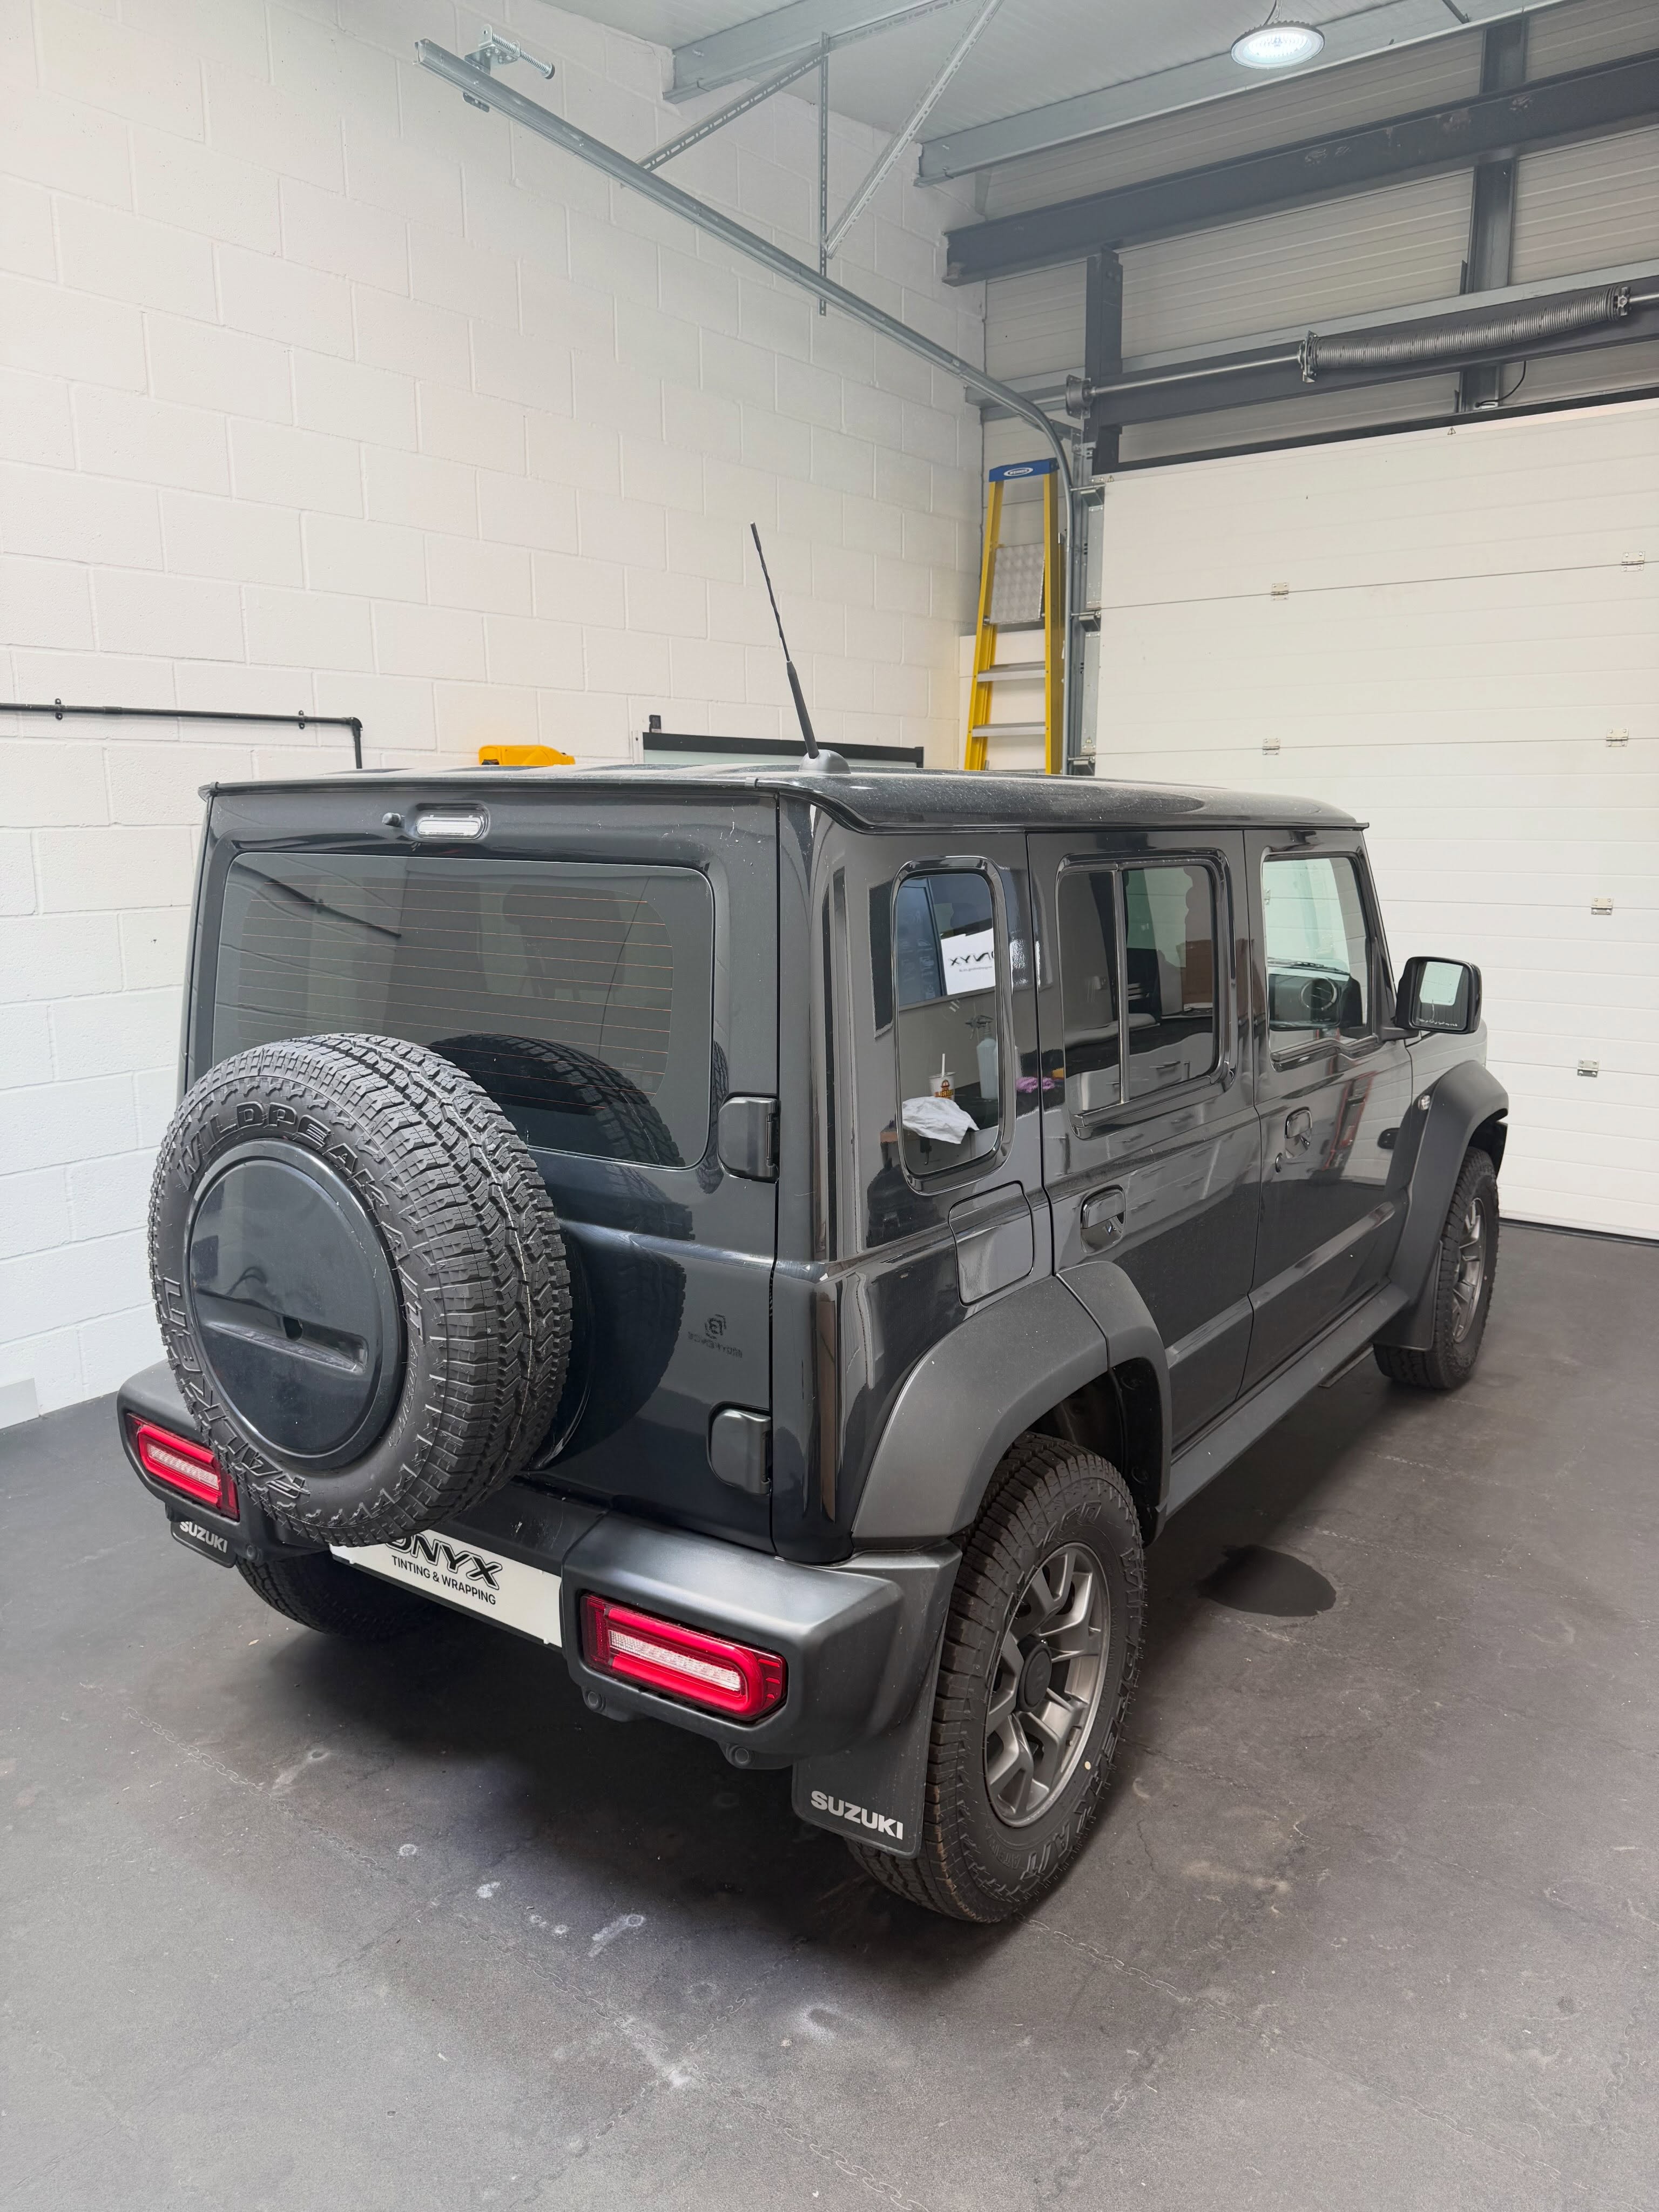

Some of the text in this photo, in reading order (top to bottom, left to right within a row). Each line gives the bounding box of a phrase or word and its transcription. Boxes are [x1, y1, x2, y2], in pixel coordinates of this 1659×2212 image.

[176, 1101, 390, 1210] WILDPEAK
[179, 1521, 228, 1554] SUZUKI
[391, 1555, 497, 1606] TINTING & WRAPPING
[810, 1790, 904, 1840] SUZUKI
